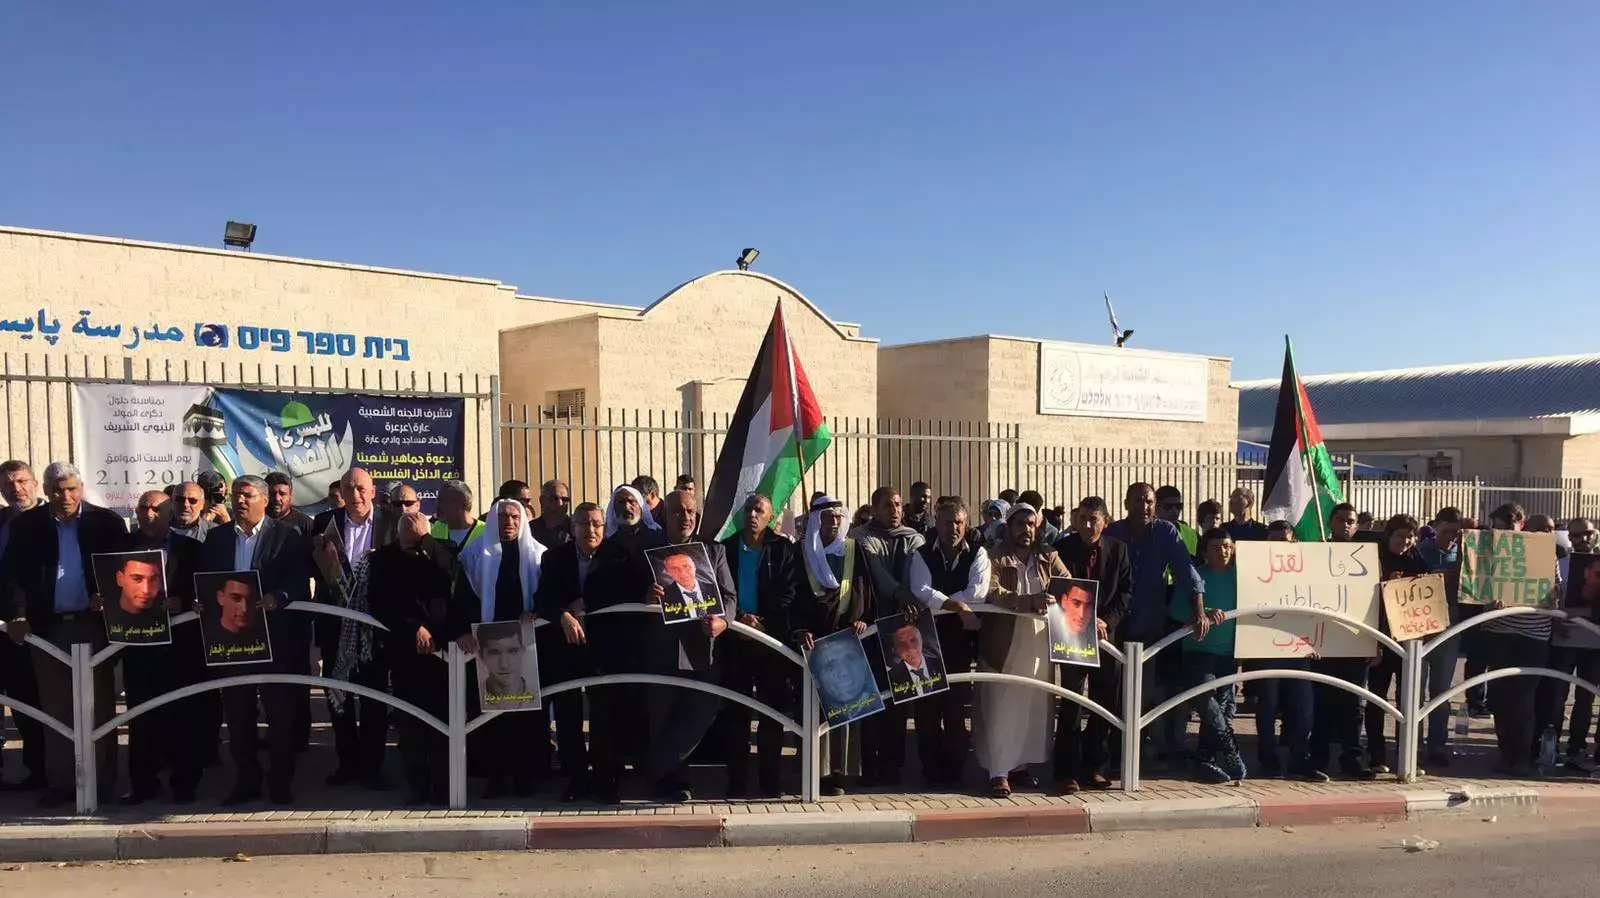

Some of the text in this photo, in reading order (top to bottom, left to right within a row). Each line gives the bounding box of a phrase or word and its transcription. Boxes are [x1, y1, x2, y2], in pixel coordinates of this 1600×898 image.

[72, 310, 184, 349] مدرسة
[238, 325, 411, 361] בית ספר פיס
[109, 396, 165, 406] بمناسبة حلول
[113, 408, 138, 418] المولد
[358, 405, 395, 418] الشعبية
[424, 407, 453, 420] تتشرف
[104, 421, 175, 434] النبوي الشريف
[402, 436, 426, 445] مساجد
[105, 453, 192, 465] يوم السبت الموافق
[357, 451, 388, 465] شعبنا
[391, 453, 424, 465] جماهير
[412, 468, 440, 480] الداخل
[442, 469, 460, 481] في
[1466, 531, 1525, 556] ARAB
[1257, 545, 1304, 583] لقتل
[142, 620, 165, 637] الشهيد
[244, 639, 266, 655] الشهيد
